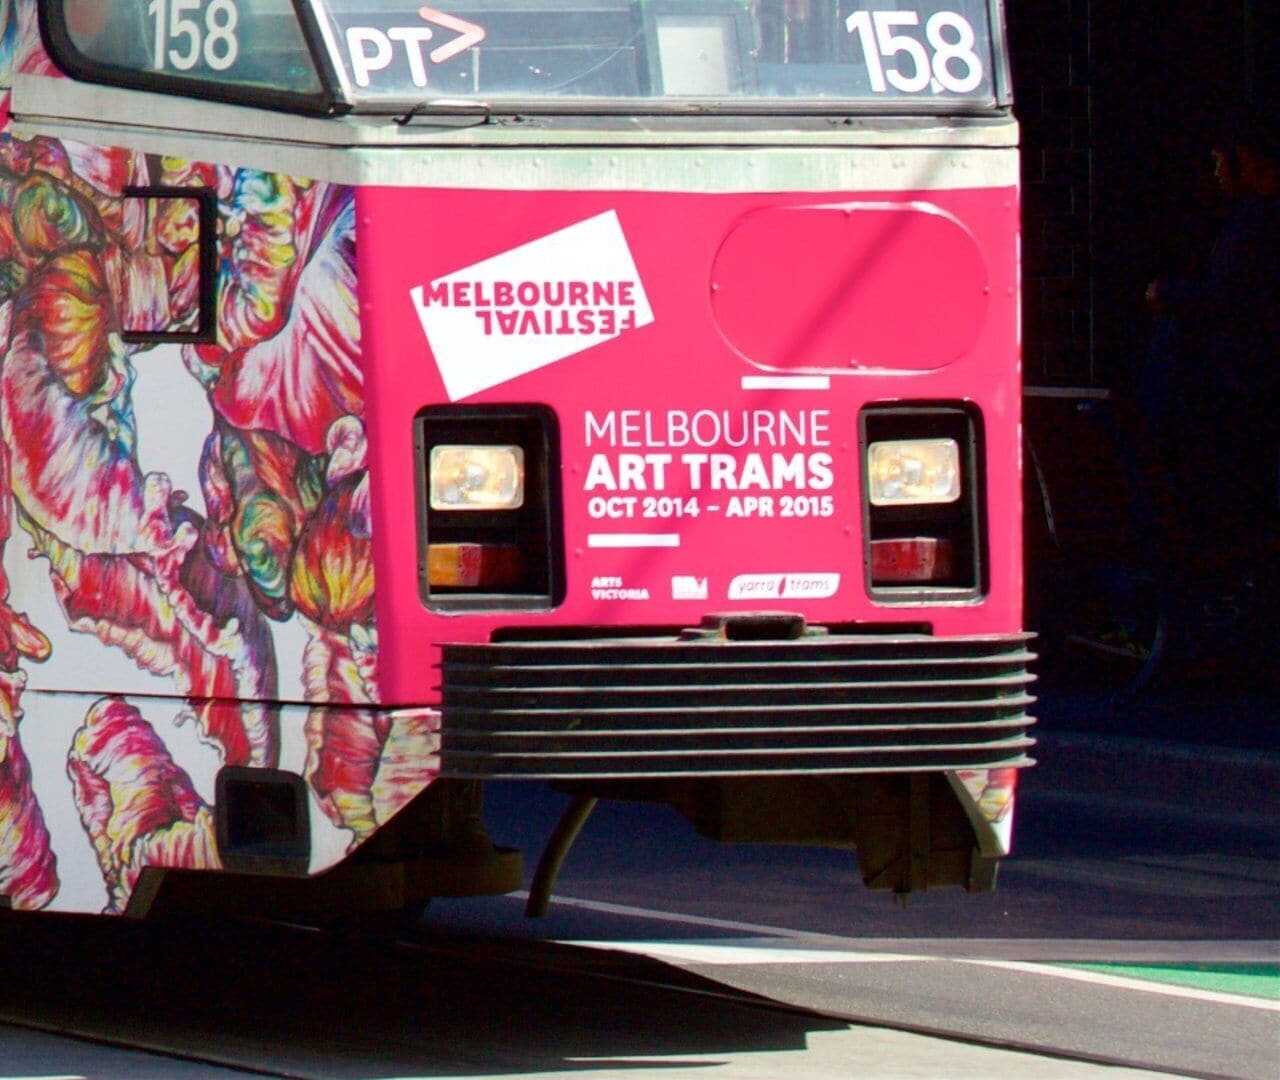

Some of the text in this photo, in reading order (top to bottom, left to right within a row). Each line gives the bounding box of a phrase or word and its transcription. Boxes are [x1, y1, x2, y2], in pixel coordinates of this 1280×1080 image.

[845, 9, 984, 94] 158
[422, 281, 635, 308] MELBOURNE
[475, 310, 635, 336] FESTIVAL
[584, 409, 831, 447] MELBOURNE
[584, 452, 834, 491] ART TRAMS
[588, 496, 637, 518] OCT
[642, 497, 700, 518] 2014
[725, 496, 774, 518] APR
[779, 495, 835, 517] 2015
[591, 576, 622, 588] ARTS
[591, 589, 649, 600] VICTORIA
[738, 576, 831, 594] yarra trams
